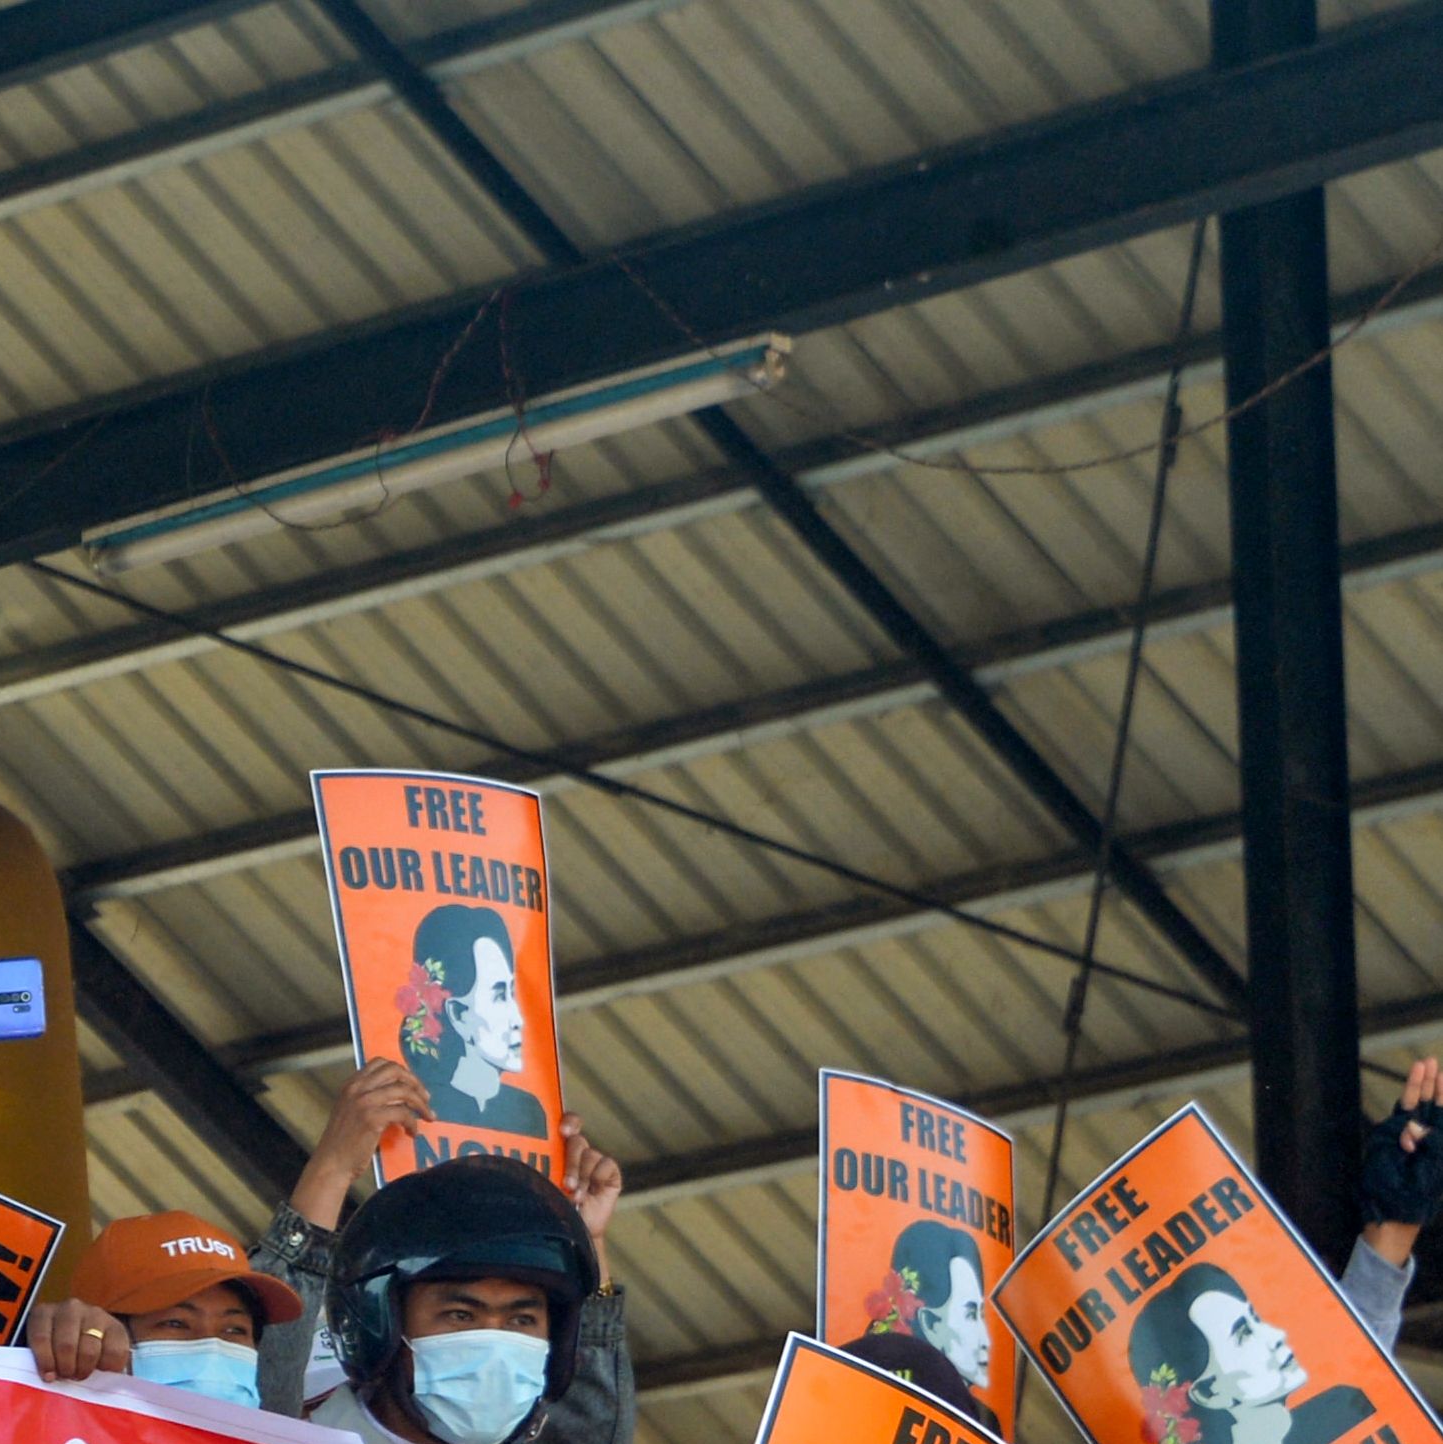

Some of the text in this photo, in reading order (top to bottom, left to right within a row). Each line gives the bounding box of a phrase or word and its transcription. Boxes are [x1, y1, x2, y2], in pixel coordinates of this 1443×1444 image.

[403, 785, 487, 836] FREE
[339, 846, 544, 913] OUR LEADER
[899, 1101, 966, 1165] FREE
[834, 1148, 1012, 1248] OUR LEADER
[1054, 1176, 1149, 1271] FREE
[160, 1236, 236, 1261] TRUST
[1040, 1175, 1255, 1376] OUR LEADER
